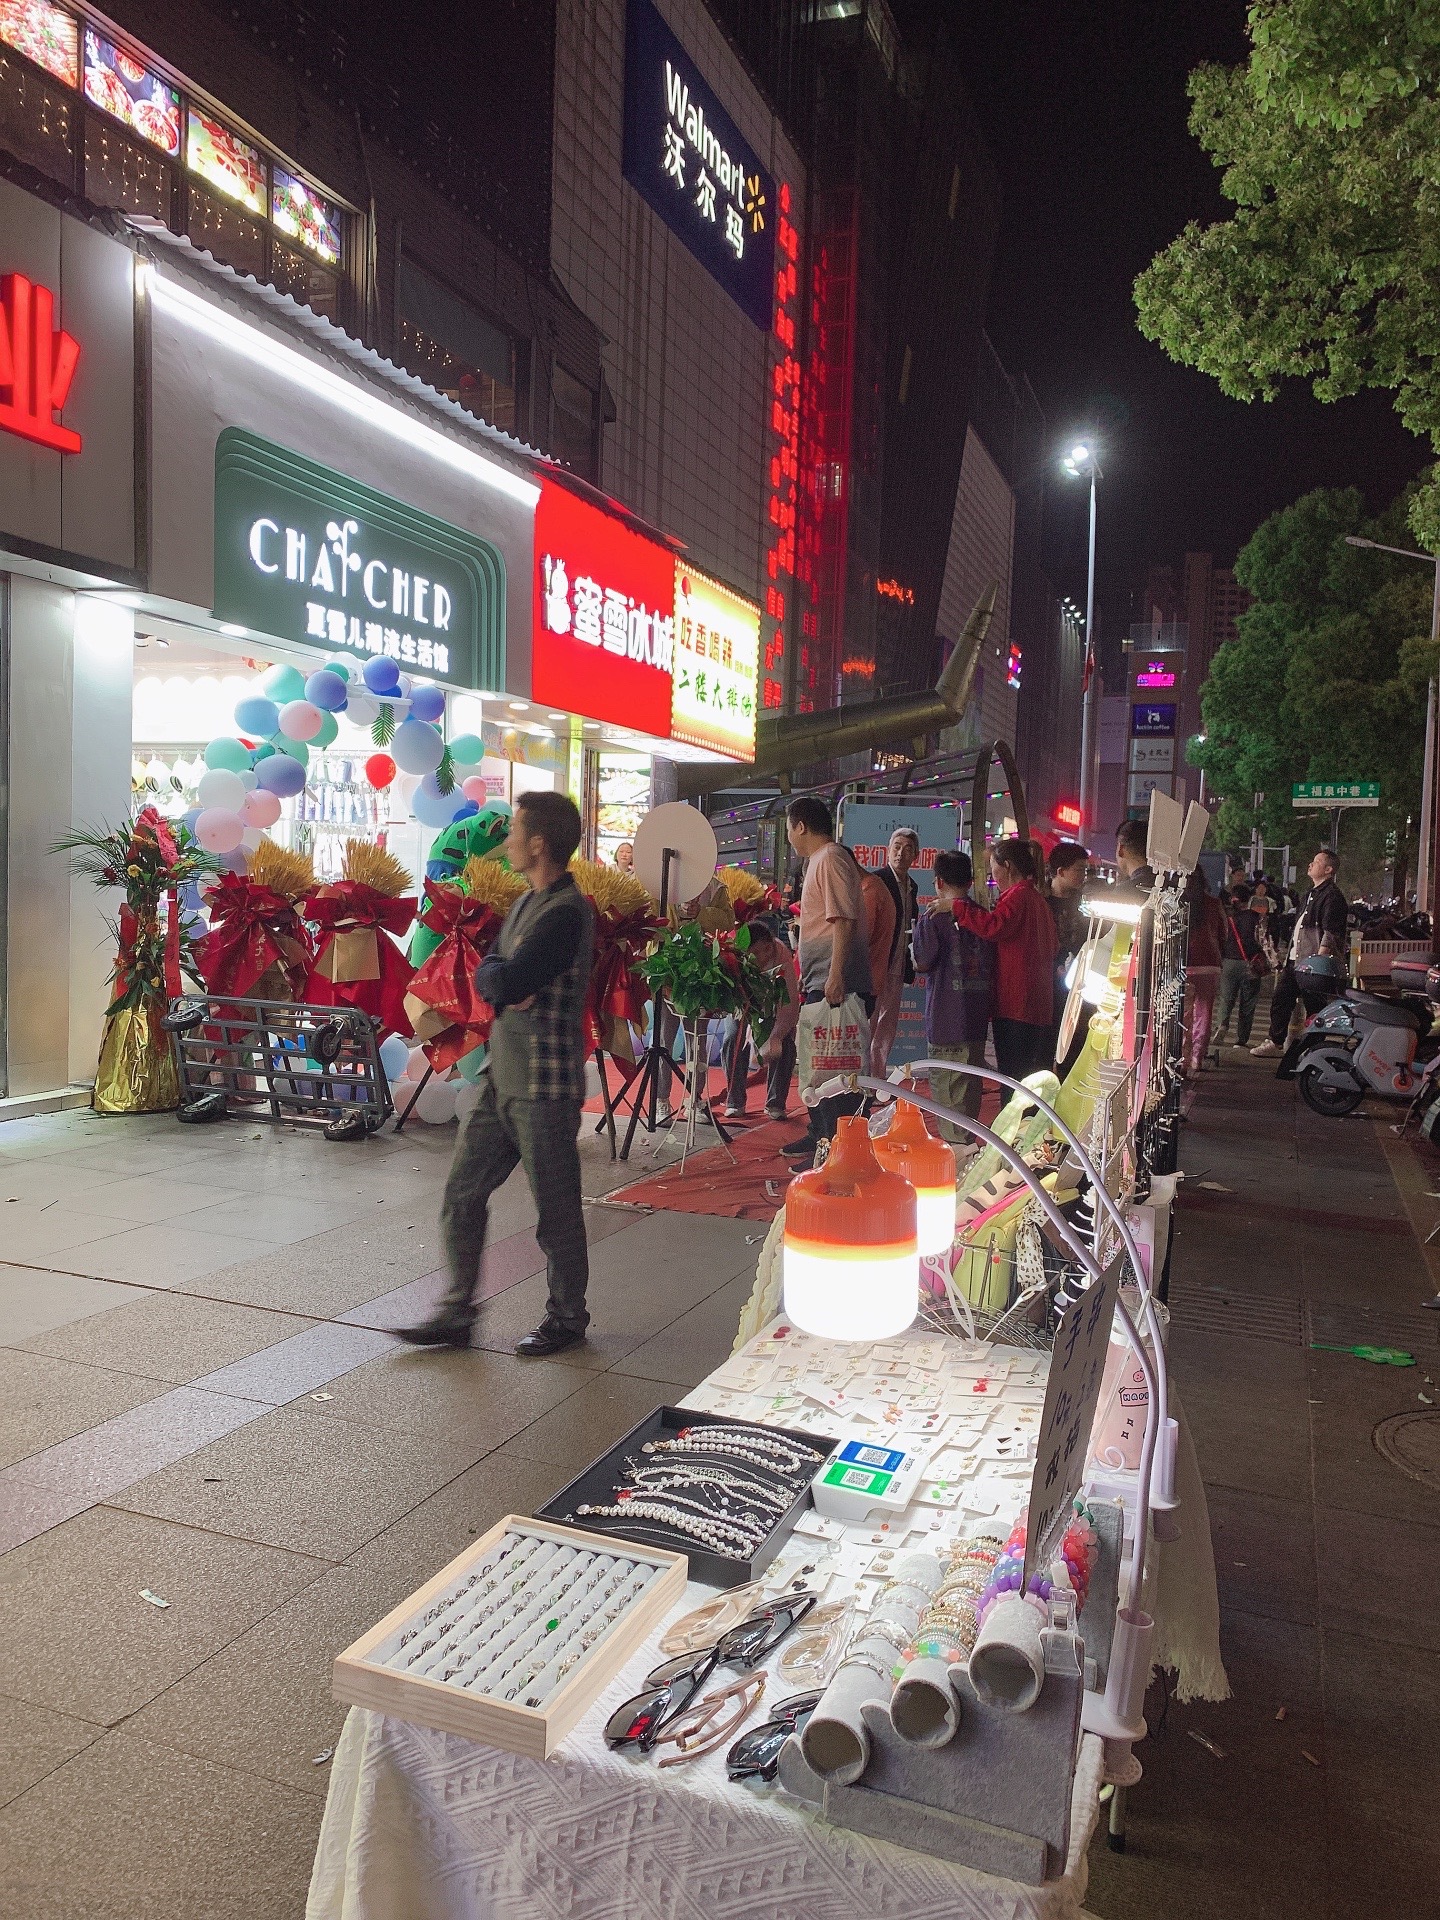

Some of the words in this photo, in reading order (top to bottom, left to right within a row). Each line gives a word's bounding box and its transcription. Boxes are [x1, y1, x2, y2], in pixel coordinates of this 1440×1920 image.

[665, 60, 745, 210] Walmart
[664, 122, 744, 259] 沃尔玛
[573, 575, 674, 675] 蜜雪冰城
[680, 616, 733, 670] 吃香喝辣
[1311, 784, 1361, 798] 福泉中巷
